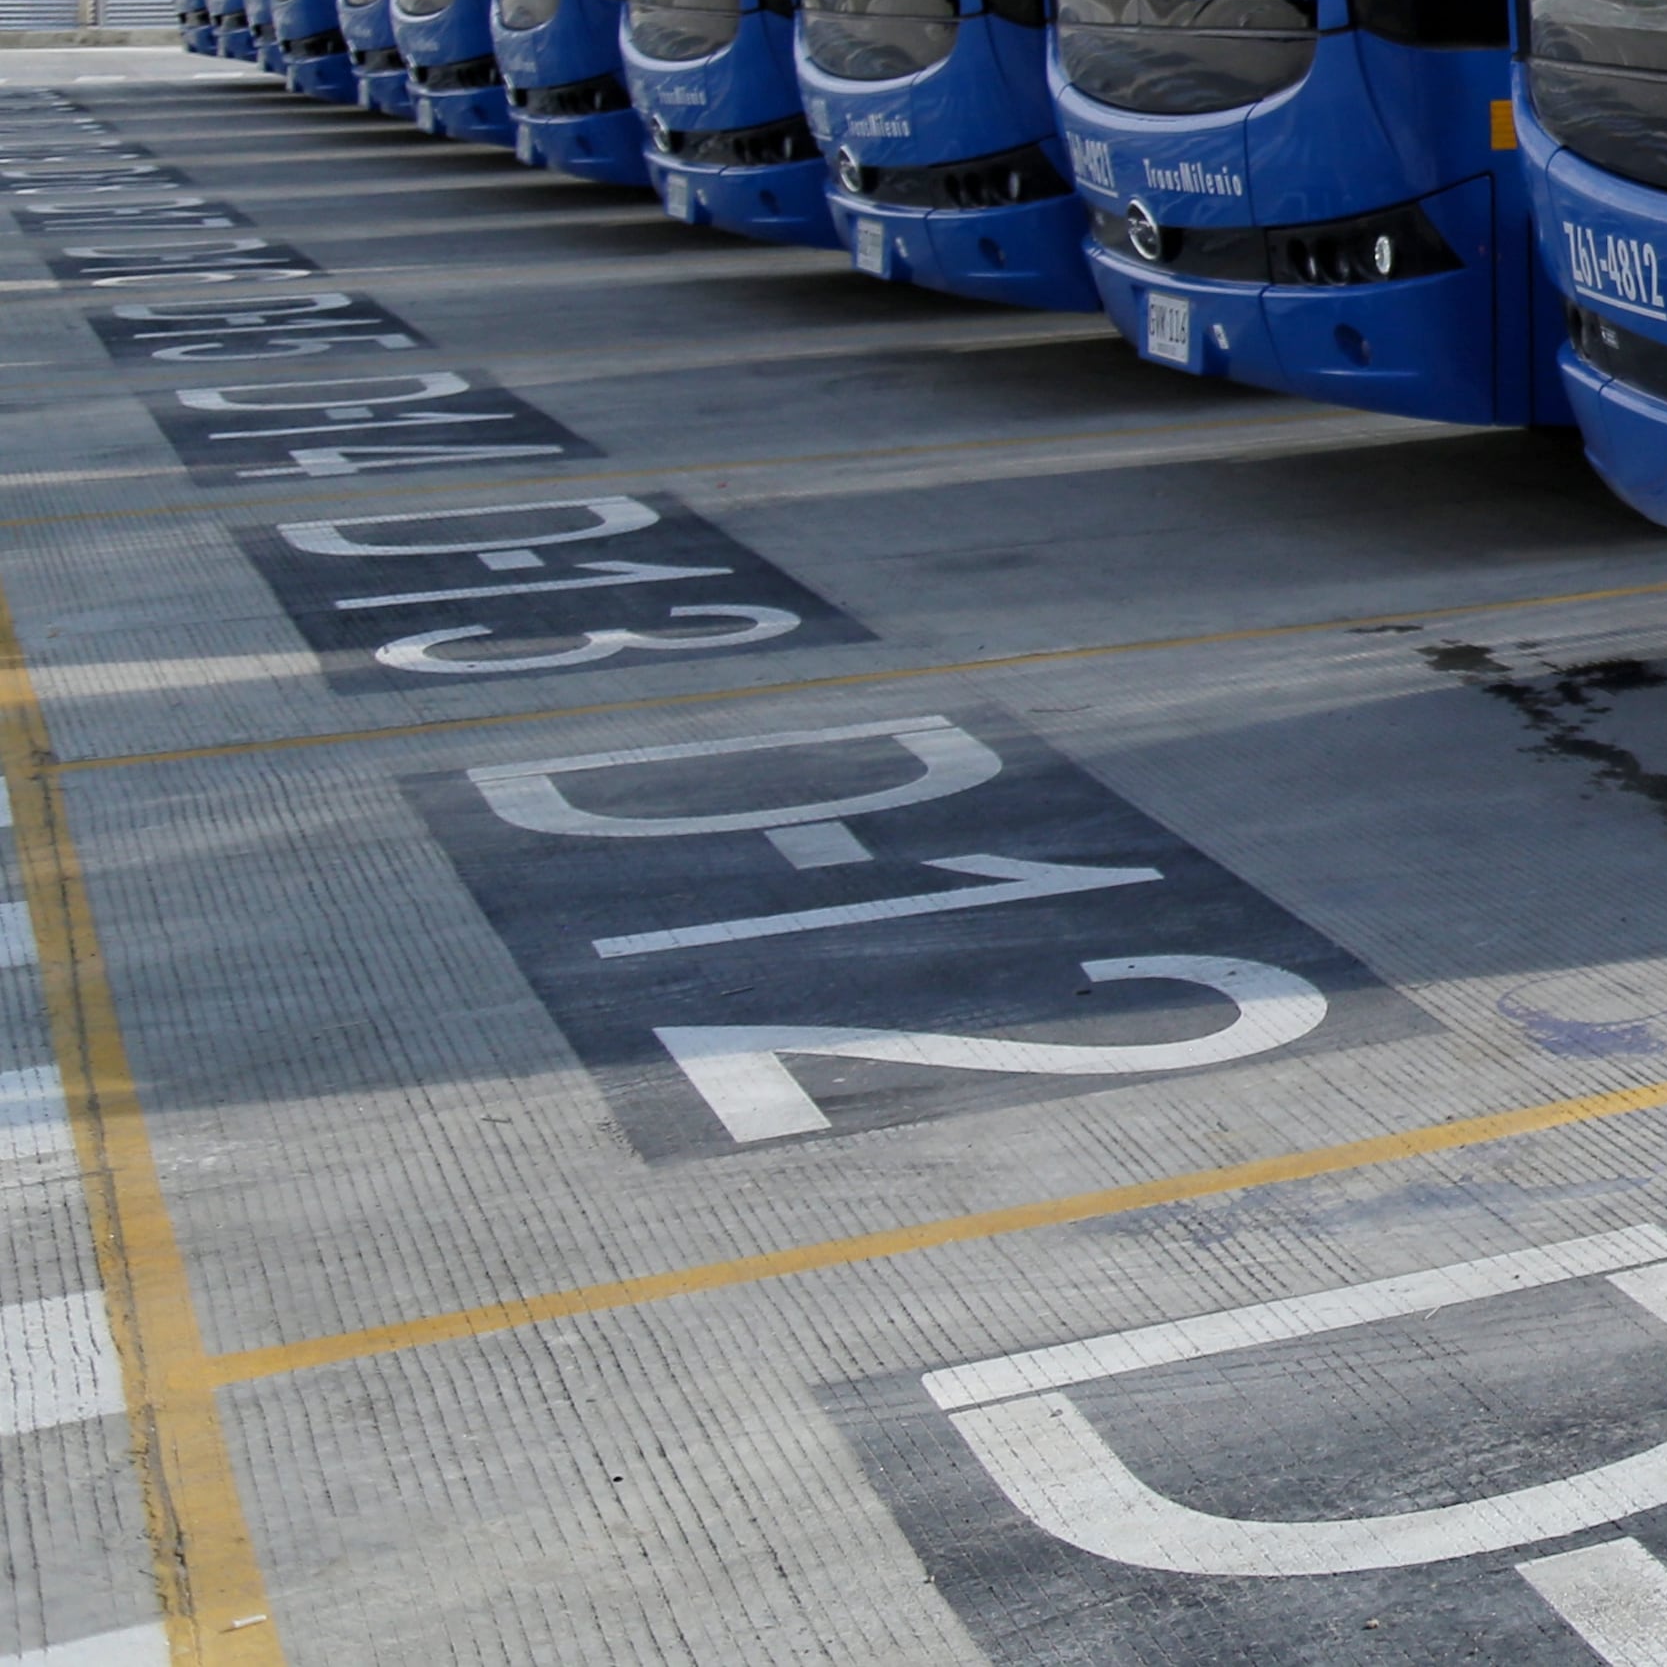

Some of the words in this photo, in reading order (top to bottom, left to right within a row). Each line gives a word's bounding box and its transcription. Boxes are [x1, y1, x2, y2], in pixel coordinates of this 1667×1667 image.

[25, 197, 236, 231] D-17
[1143, 158, 1242, 197] TransMilenio
[62, 237, 313, 287] D-16
[1563, 221, 1665, 308] Z61-4812
[111, 291, 418, 363] D-15
[175, 370, 564, 479] D-14
[276, 495, 801, 675] D-13
[466, 714, 1329, 1143] D-12
